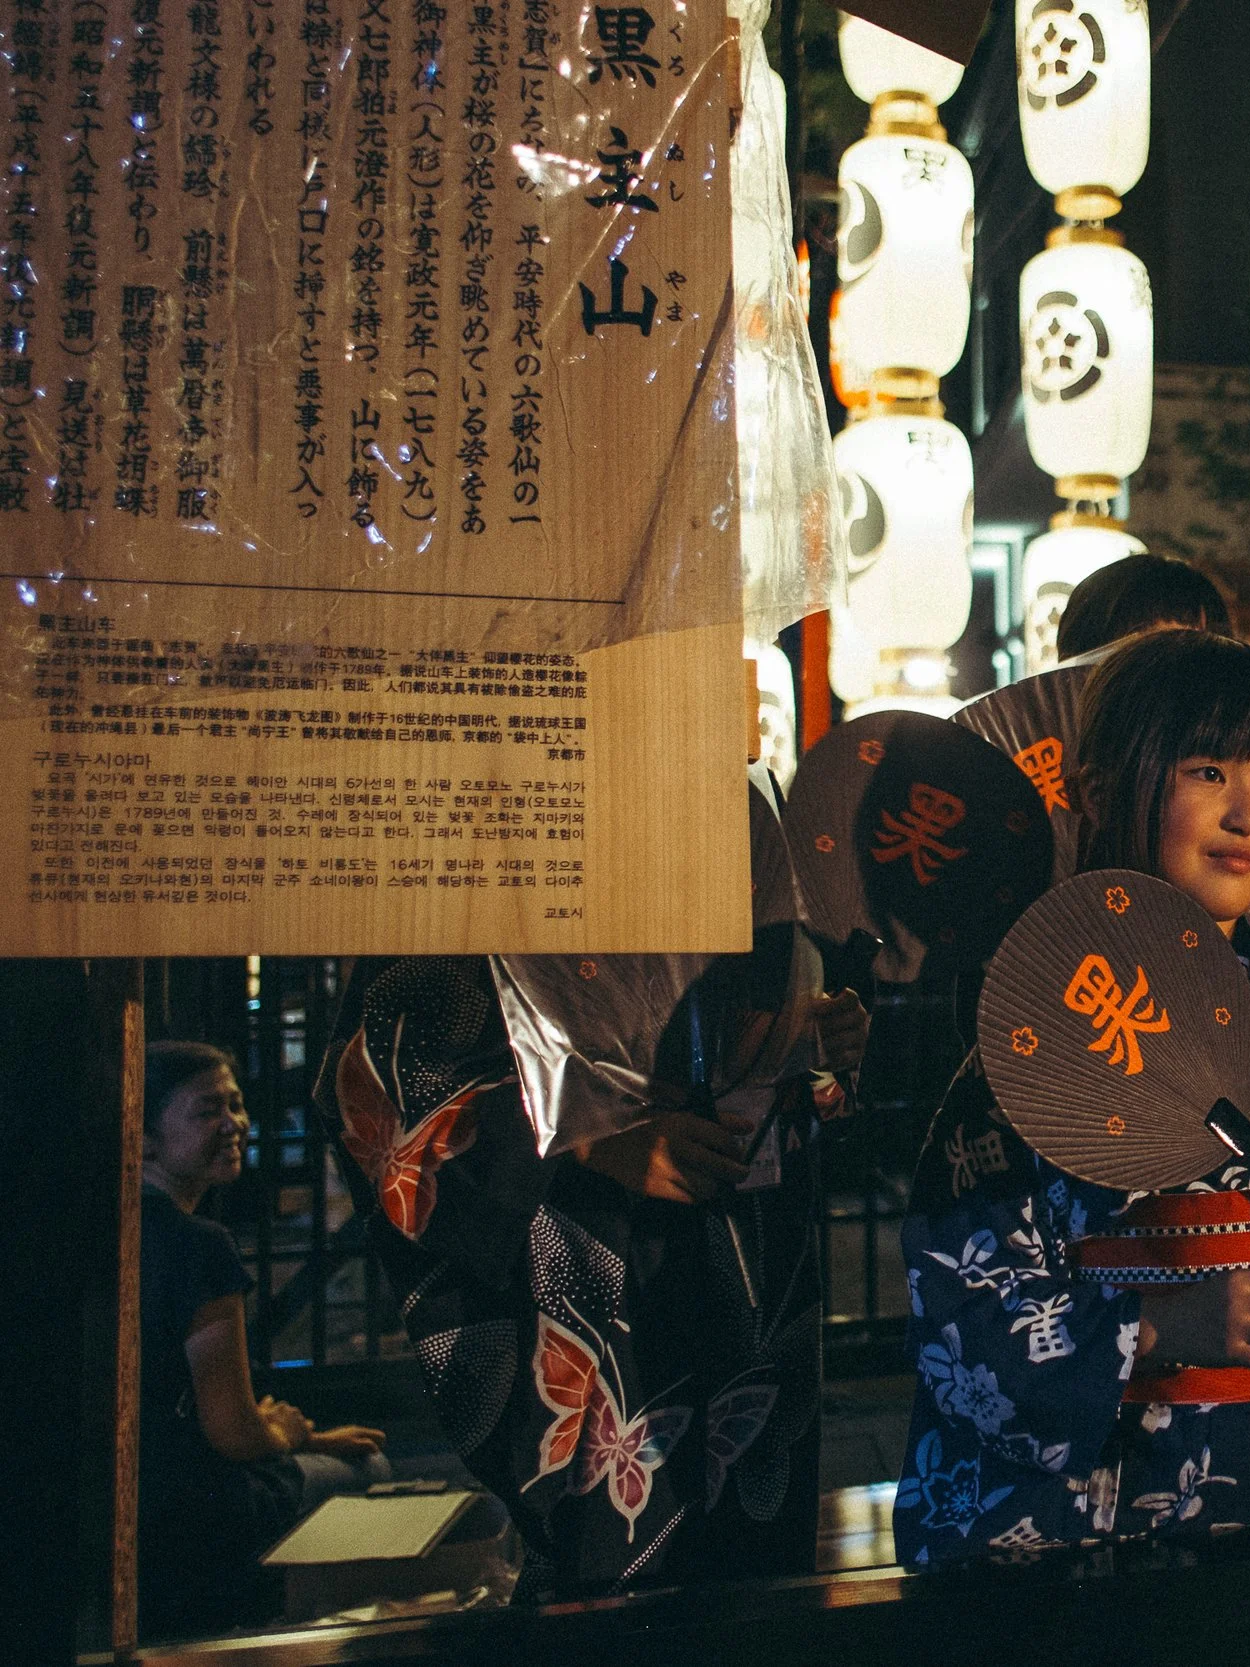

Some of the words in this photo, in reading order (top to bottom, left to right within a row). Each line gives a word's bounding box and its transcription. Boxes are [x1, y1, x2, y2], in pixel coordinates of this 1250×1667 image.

[246, 0, 276, 136] いわれる
[578, 5, 663, 338] 黒主山
[33, 751, 152, 769] 구로누시야마
[547, 748, 586, 761] 京都市
[196, 773, 236, 789] 것으로
[298, 774, 337, 791] 시대의
[345, 775, 395, 792] 6가선의
[426, 775, 451, 792] 사람
[461, 776, 512, 793] 오토모노
[521, 776, 585, 794] 구로누시가
[406, 792, 444, 808] 모시는
[298, 807, 337, 824] 수레에
[349, 808, 401, 824] 장식되어
[413, 808, 438, 825] 있는
[534, 810, 584, 826] 지마키와
[320, 824, 374, 841] 않는다고
[384, 824, 414, 841] 한다.
[423, 825, 462, 841] 그래서
[497, 857, 534, 873] 시대의
[546, 857, 583, 873] 것으로
[544, 907, 583, 920] 교토시
